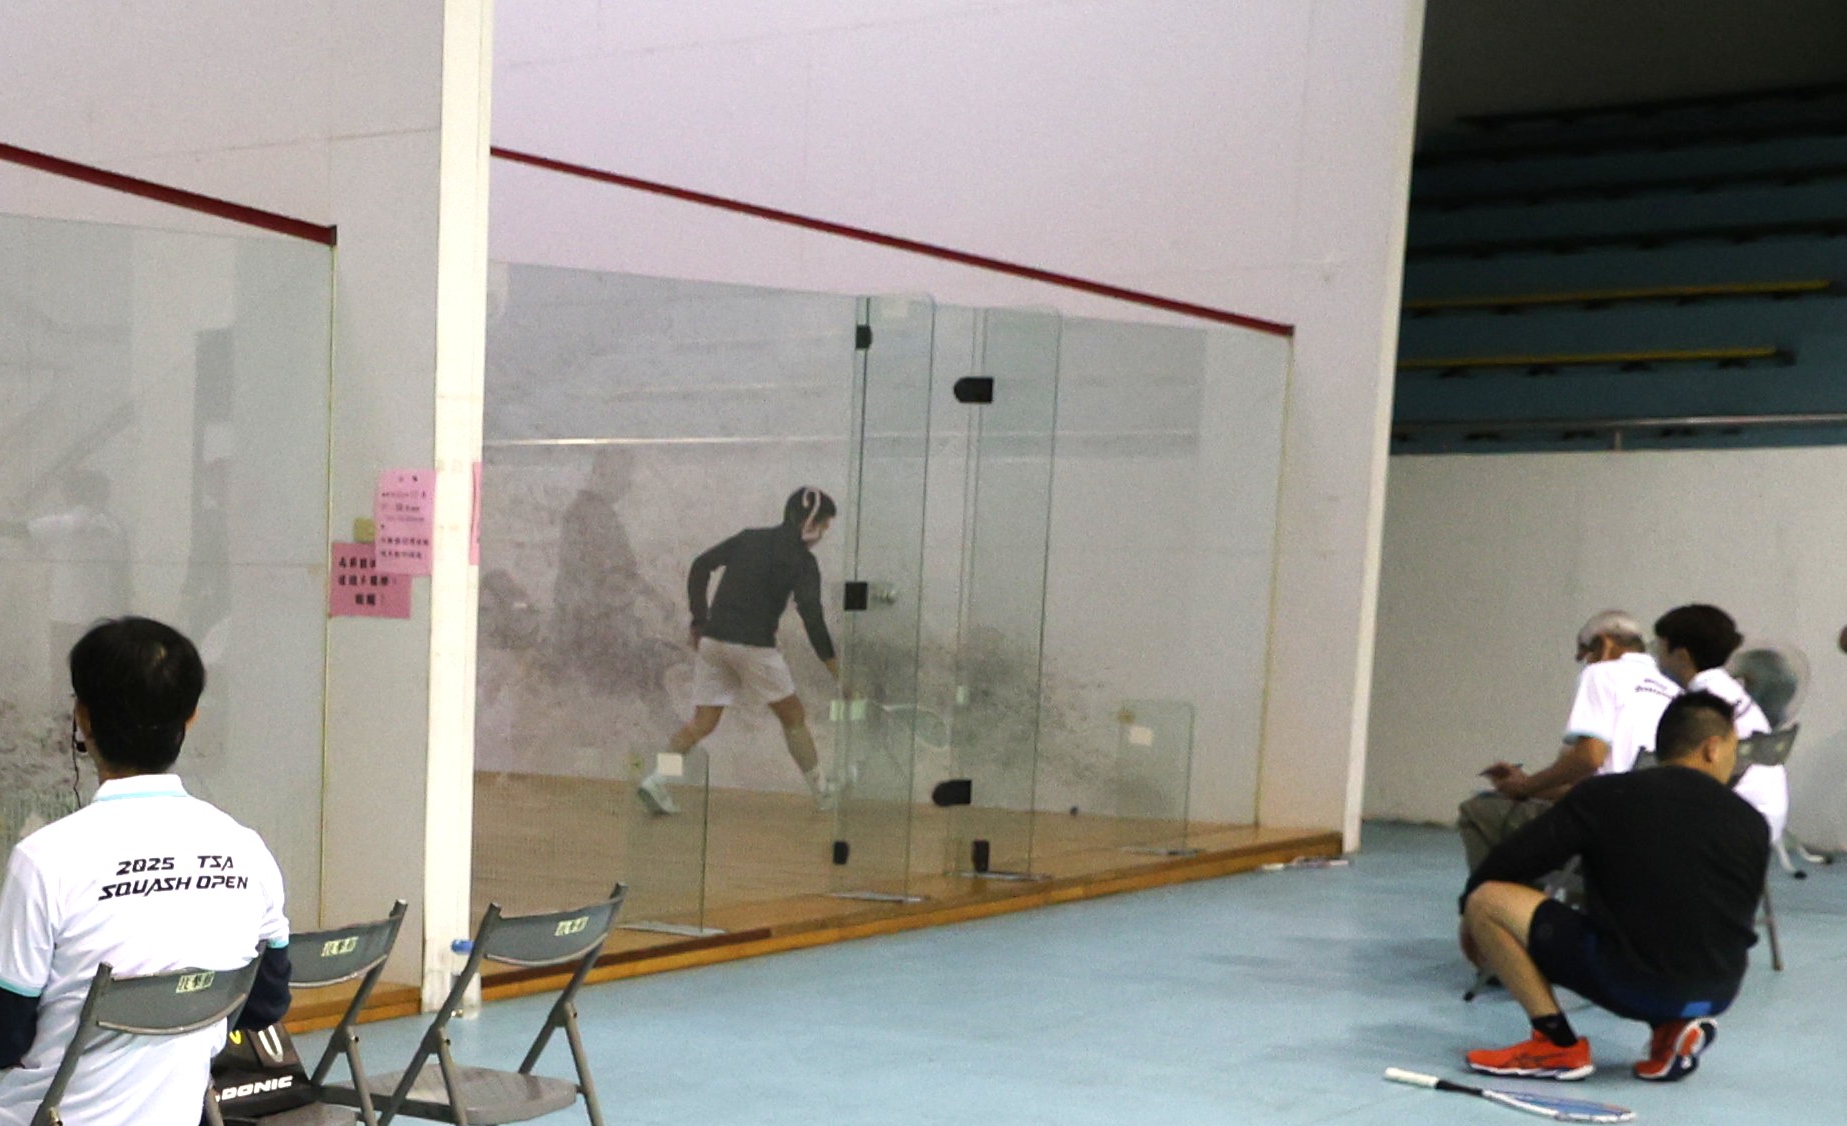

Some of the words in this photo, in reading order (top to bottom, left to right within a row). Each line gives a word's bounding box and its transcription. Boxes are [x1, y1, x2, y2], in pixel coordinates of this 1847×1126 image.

[115, 856, 176, 876] 2025
[196, 854, 235, 872] TSA
[98, 876, 193, 902] SQUASH
[195, 875, 249, 890] OPEN
